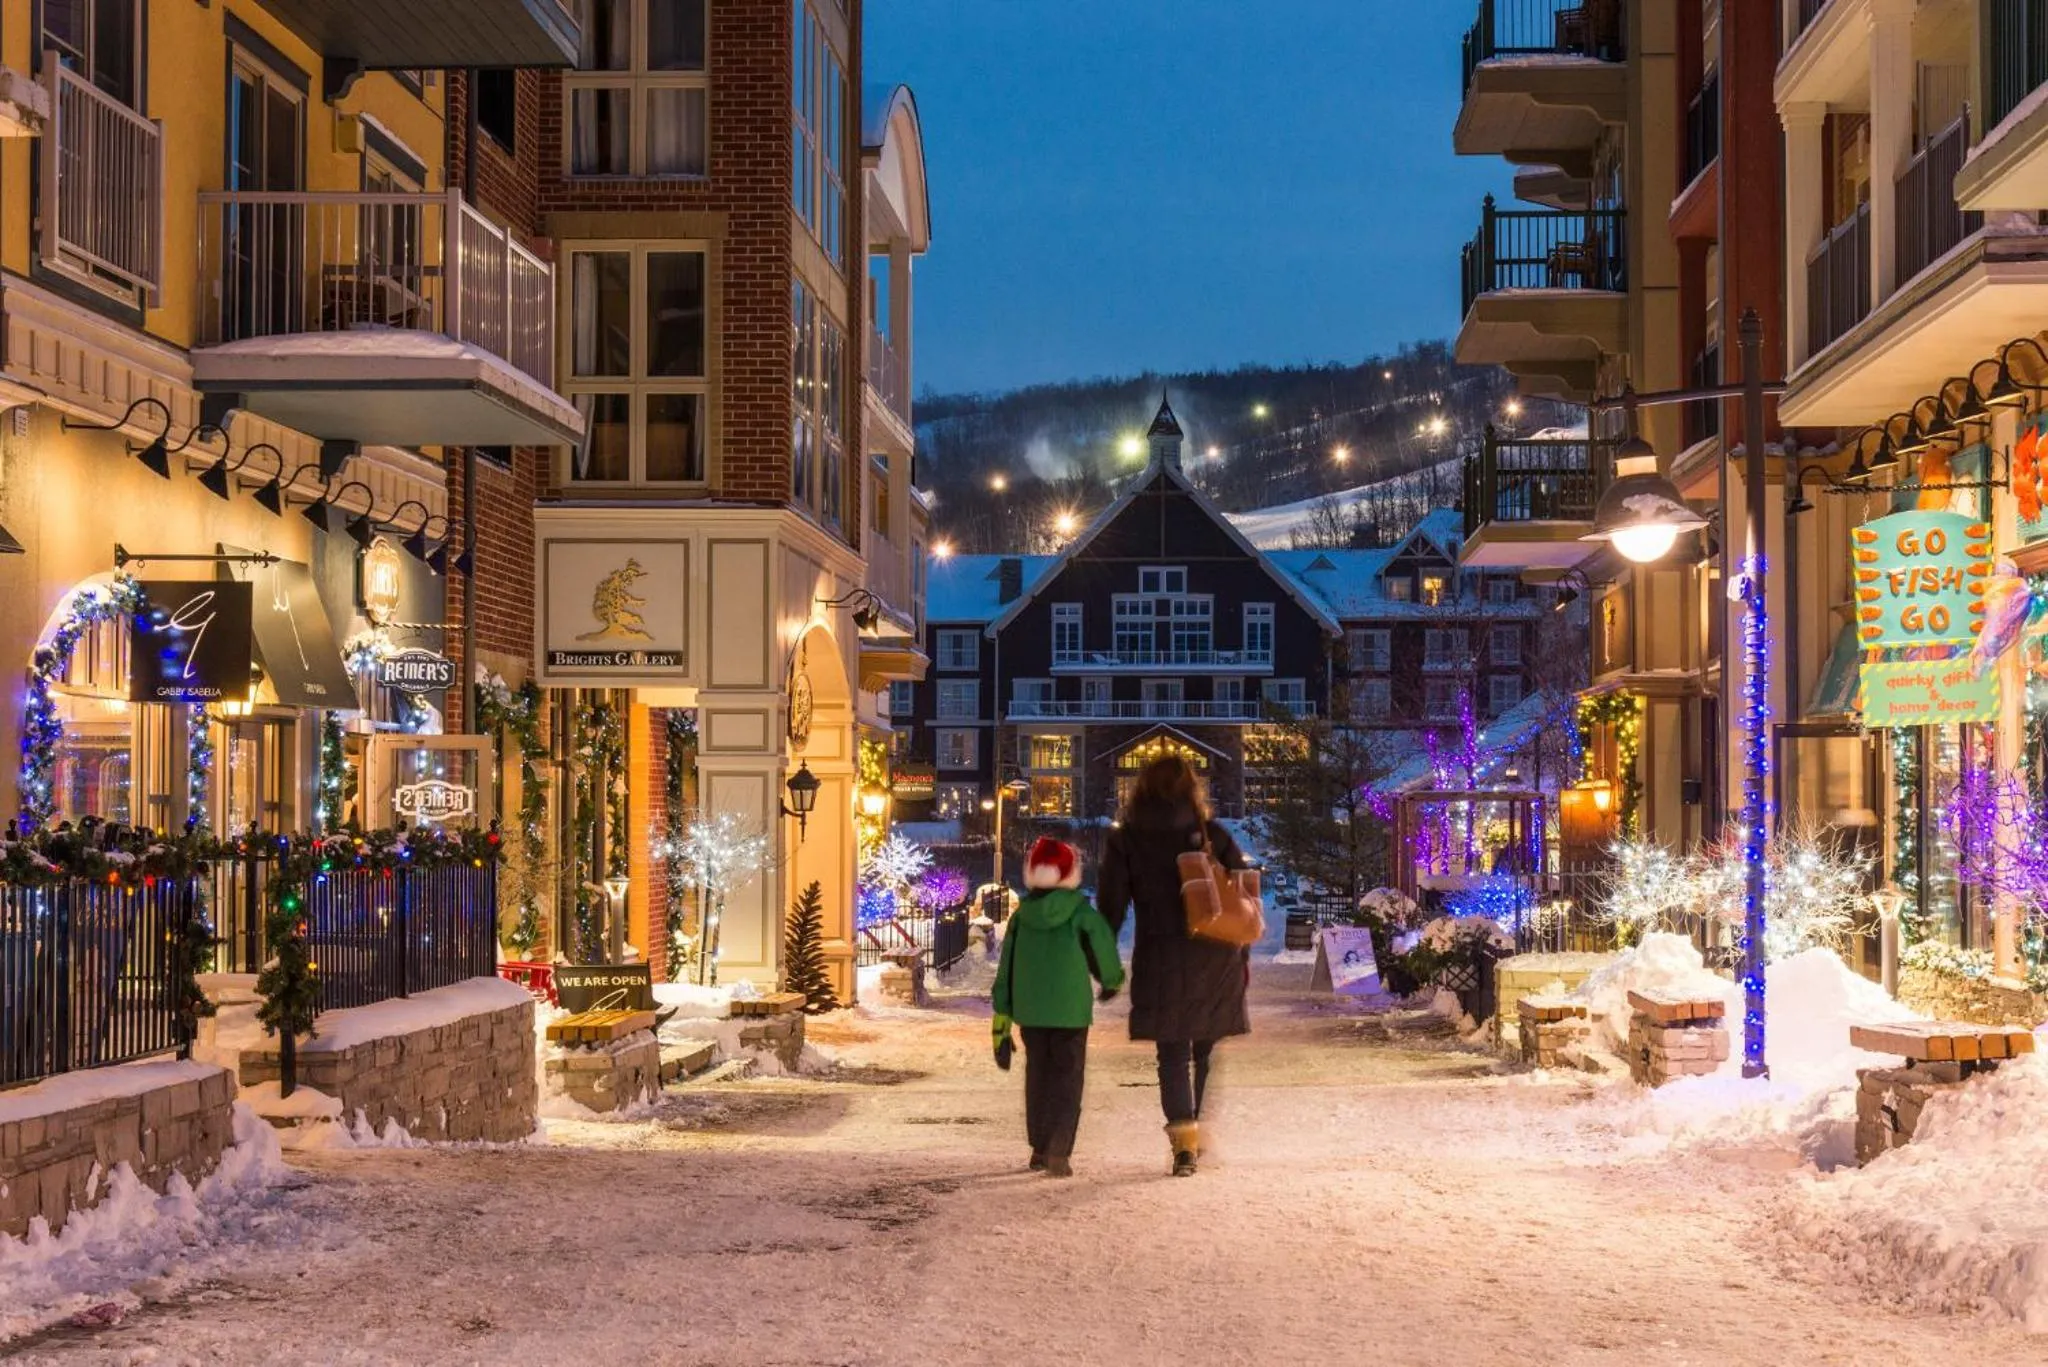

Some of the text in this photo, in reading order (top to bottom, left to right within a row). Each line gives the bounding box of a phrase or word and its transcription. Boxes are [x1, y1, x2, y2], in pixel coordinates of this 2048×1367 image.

[1896, 528, 1947, 556] GO
[1886, 566, 1964, 598] FISH
[1901, 604, 1950, 634] GO
[1886, 672, 1935, 689] quirky
[1929, 688, 1940, 701] &
[1889, 700, 1977, 714] home decor
[560, 975, 647, 987] WE ARE OPEN
